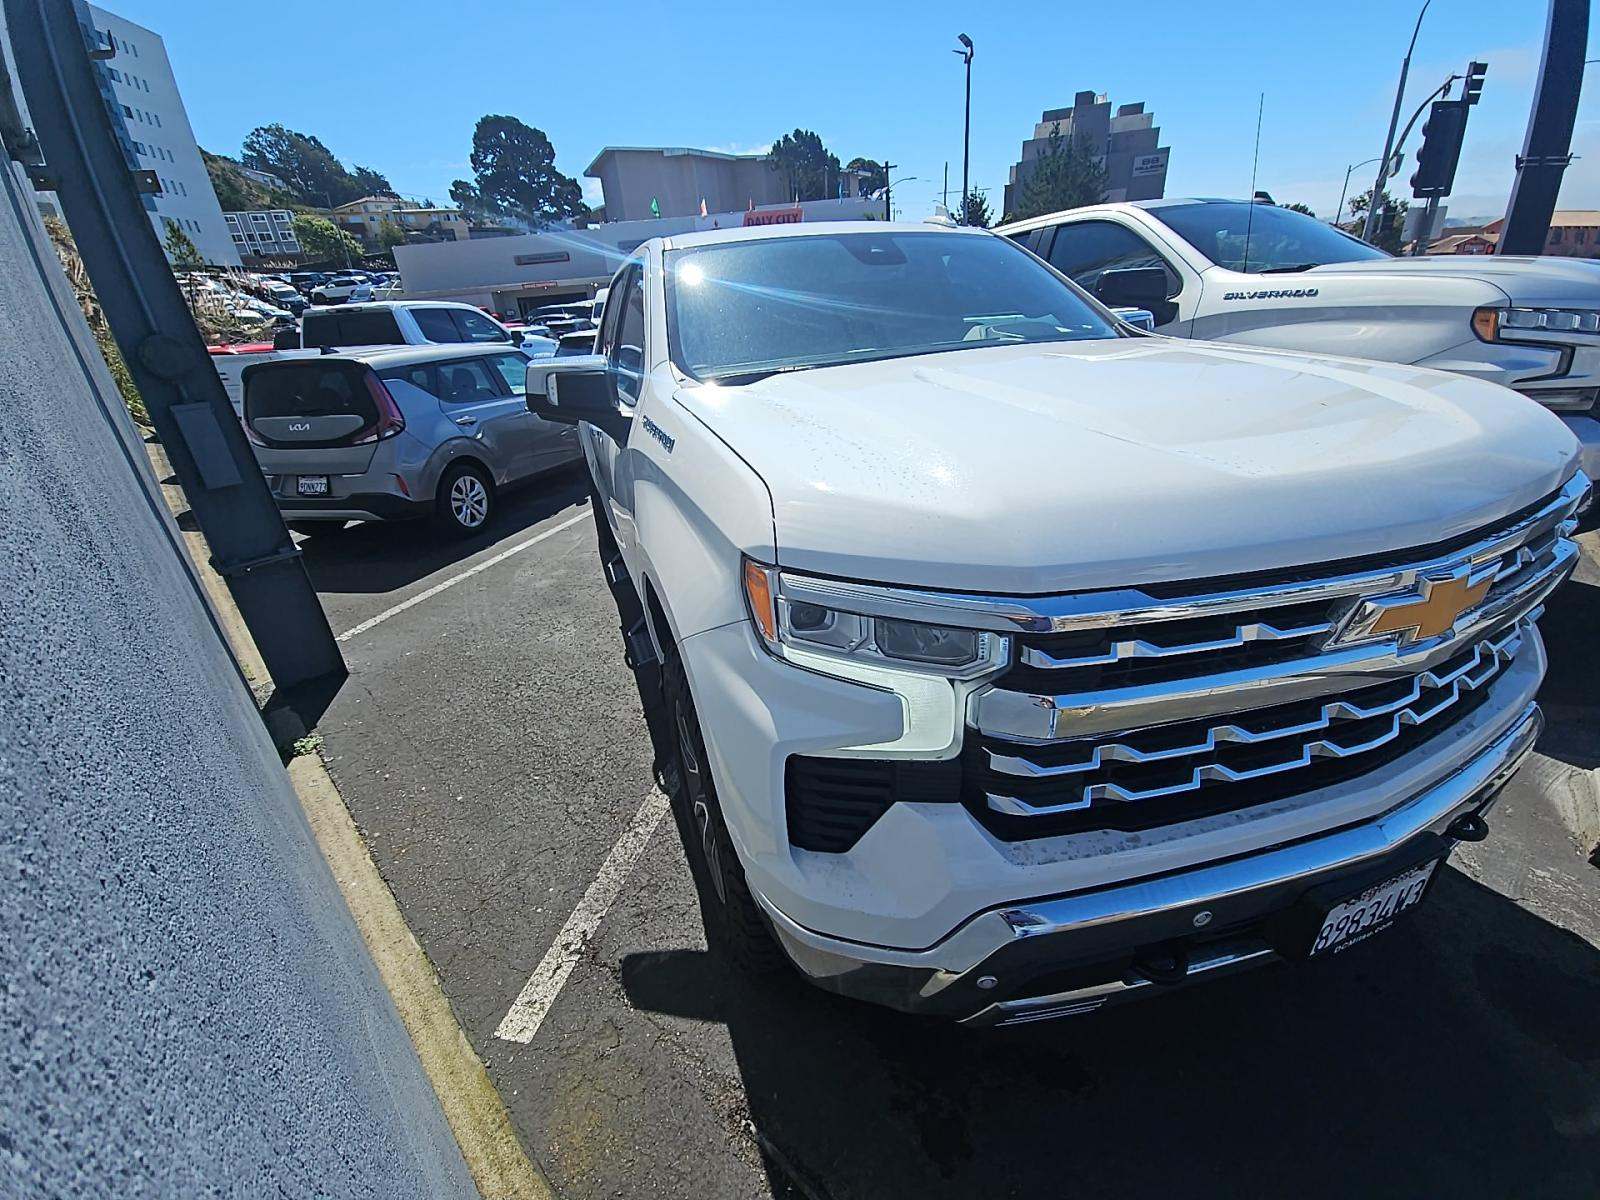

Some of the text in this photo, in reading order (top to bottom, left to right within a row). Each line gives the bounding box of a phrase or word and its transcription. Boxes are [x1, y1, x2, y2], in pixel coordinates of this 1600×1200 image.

[747, 213, 799, 226] DALY CITY
[1223, 288, 1319, 301] SILVERADO
